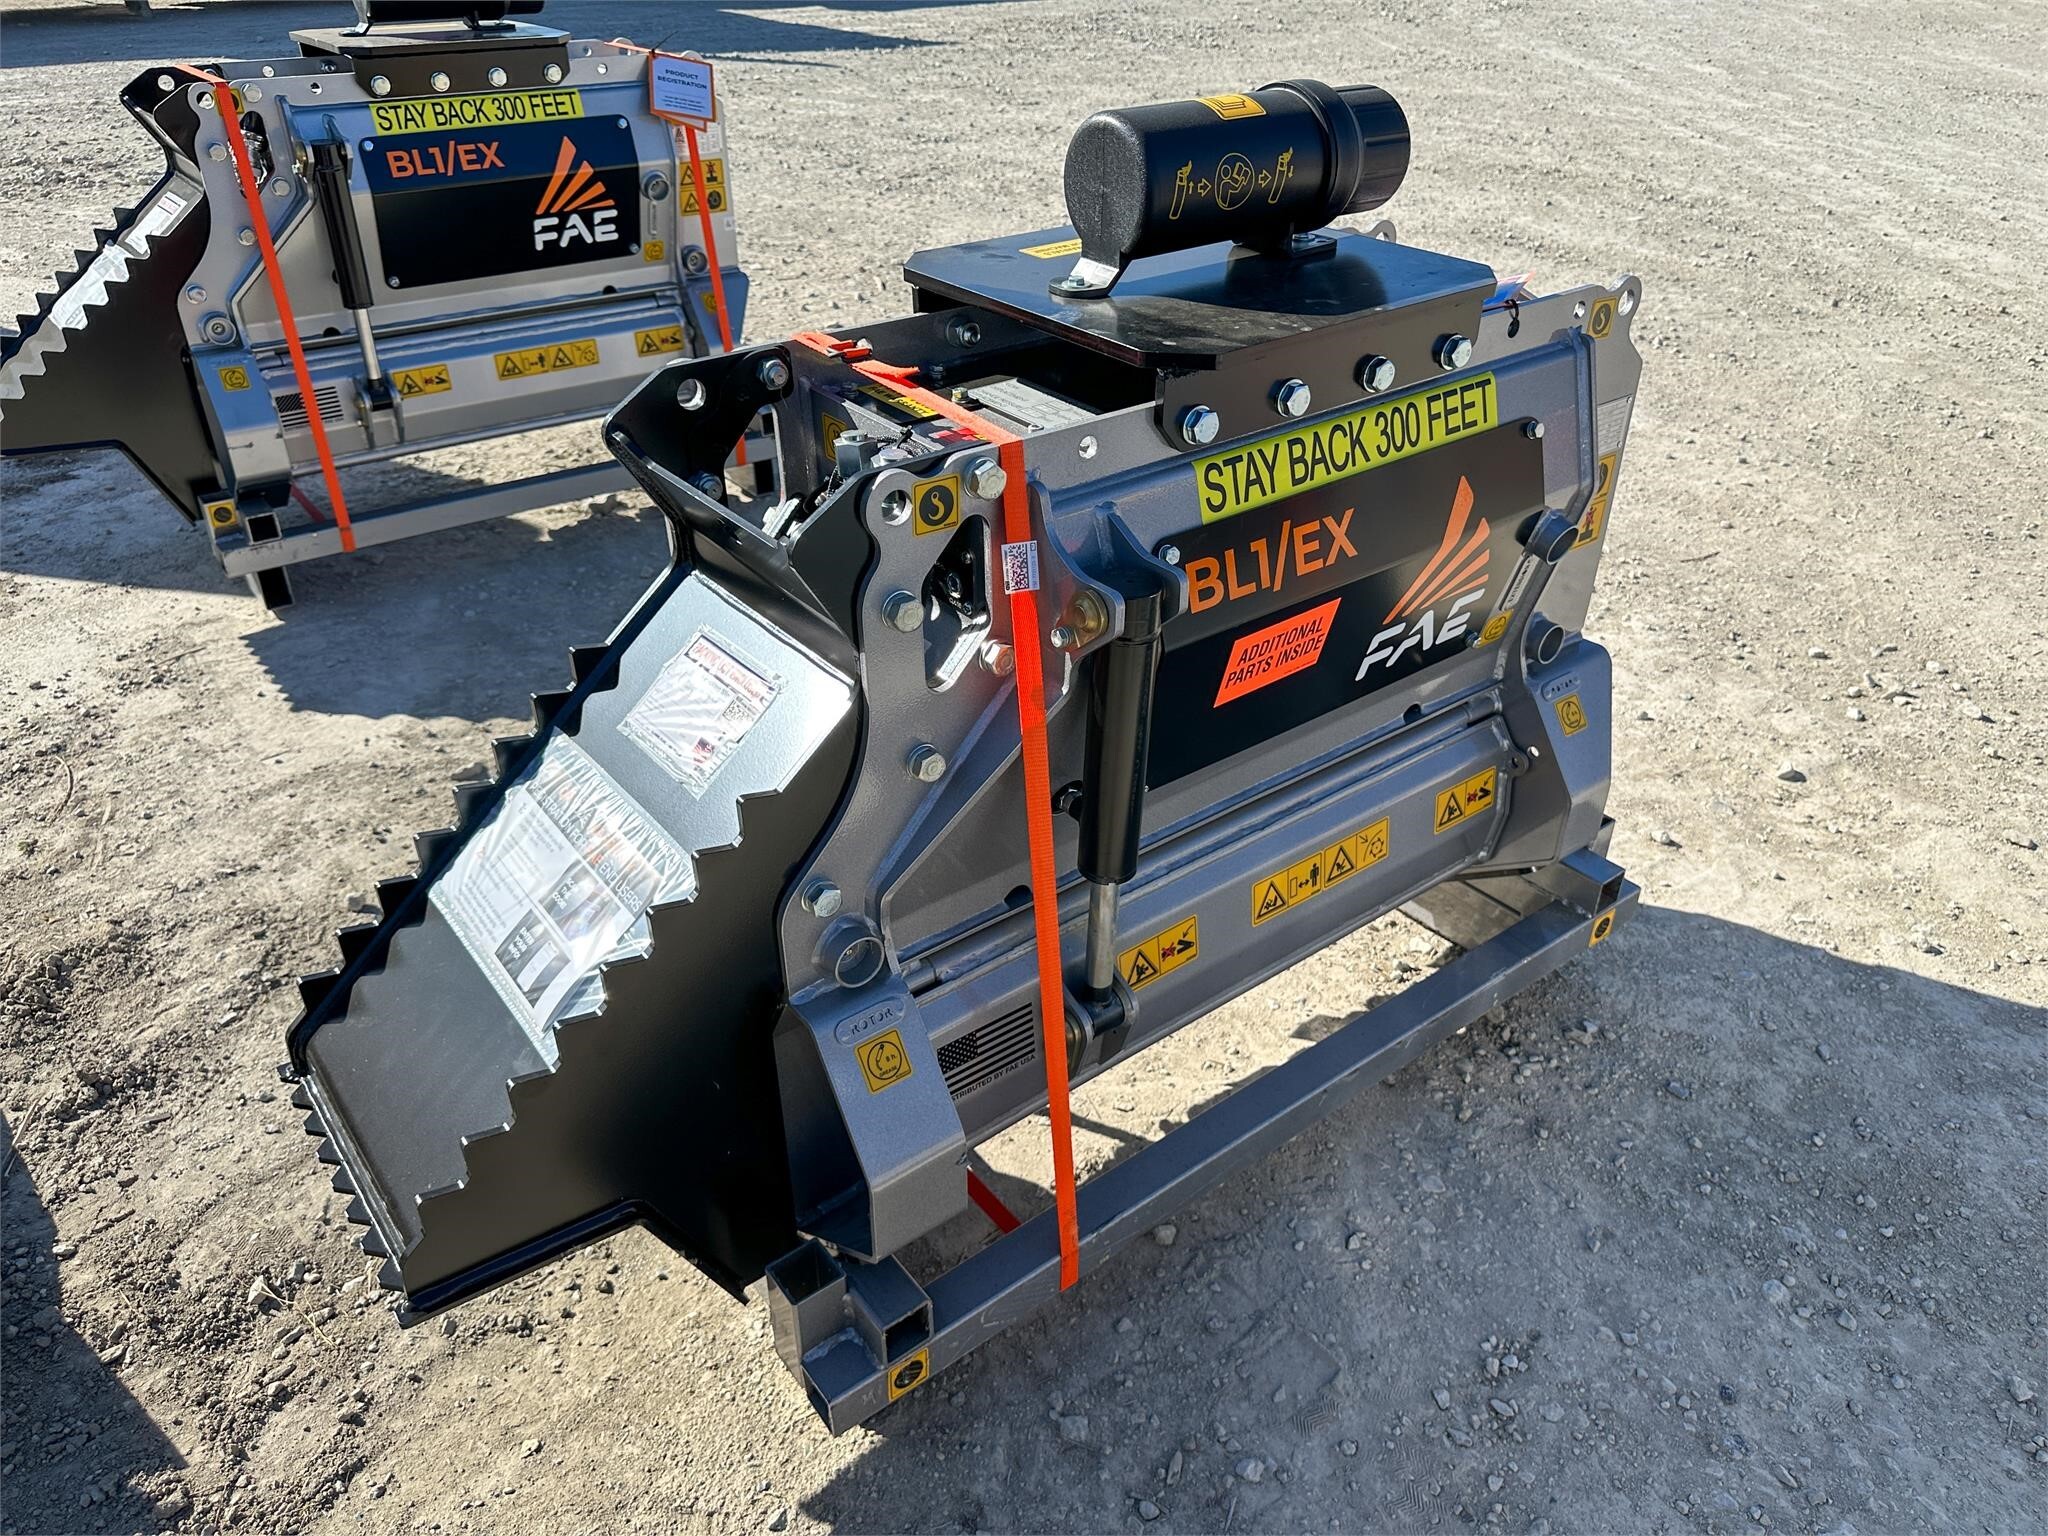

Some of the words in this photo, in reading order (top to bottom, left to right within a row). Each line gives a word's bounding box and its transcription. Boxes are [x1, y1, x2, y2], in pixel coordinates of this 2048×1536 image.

[657, 76, 707, 89] REGISTRATION
[666, 69, 698, 80] PRODUCT
[376, 103, 426, 132] STAY
[432, 98, 492, 127] BACK
[491, 95, 526, 121] 300
[530, 91, 578, 118] FEET
[386, 140, 505, 178] BL1/EX
[533, 209, 619, 251] FAE
[1203, 443, 1280, 514] STAY
[1287, 416, 1371, 488] BACK
[1374, 402, 1421, 458] 300
[1427, 378, 1492, 442] FEET
[1185, 508, 1359, 615] BL1/EX
[1236, 617, 1323, 666] ADDITIONAL
[1355, 588, 1486, 682] FAE
[1225, 656, 1272, 689] PARTS
[1276, 635, 1323, 670] INSIDE
[597, 861, 620, 884] END
[613, 879, 644, 912] USERS
[852, 1008, 893, 1035] ROTOR
[952, 1077, 992, 1100] STRIBUTED
[994, 1071, 1004, 1080] BY
[1005, 1065, 1019, 1074] FAE
[1020, 1054, 1035, 1065] USA
